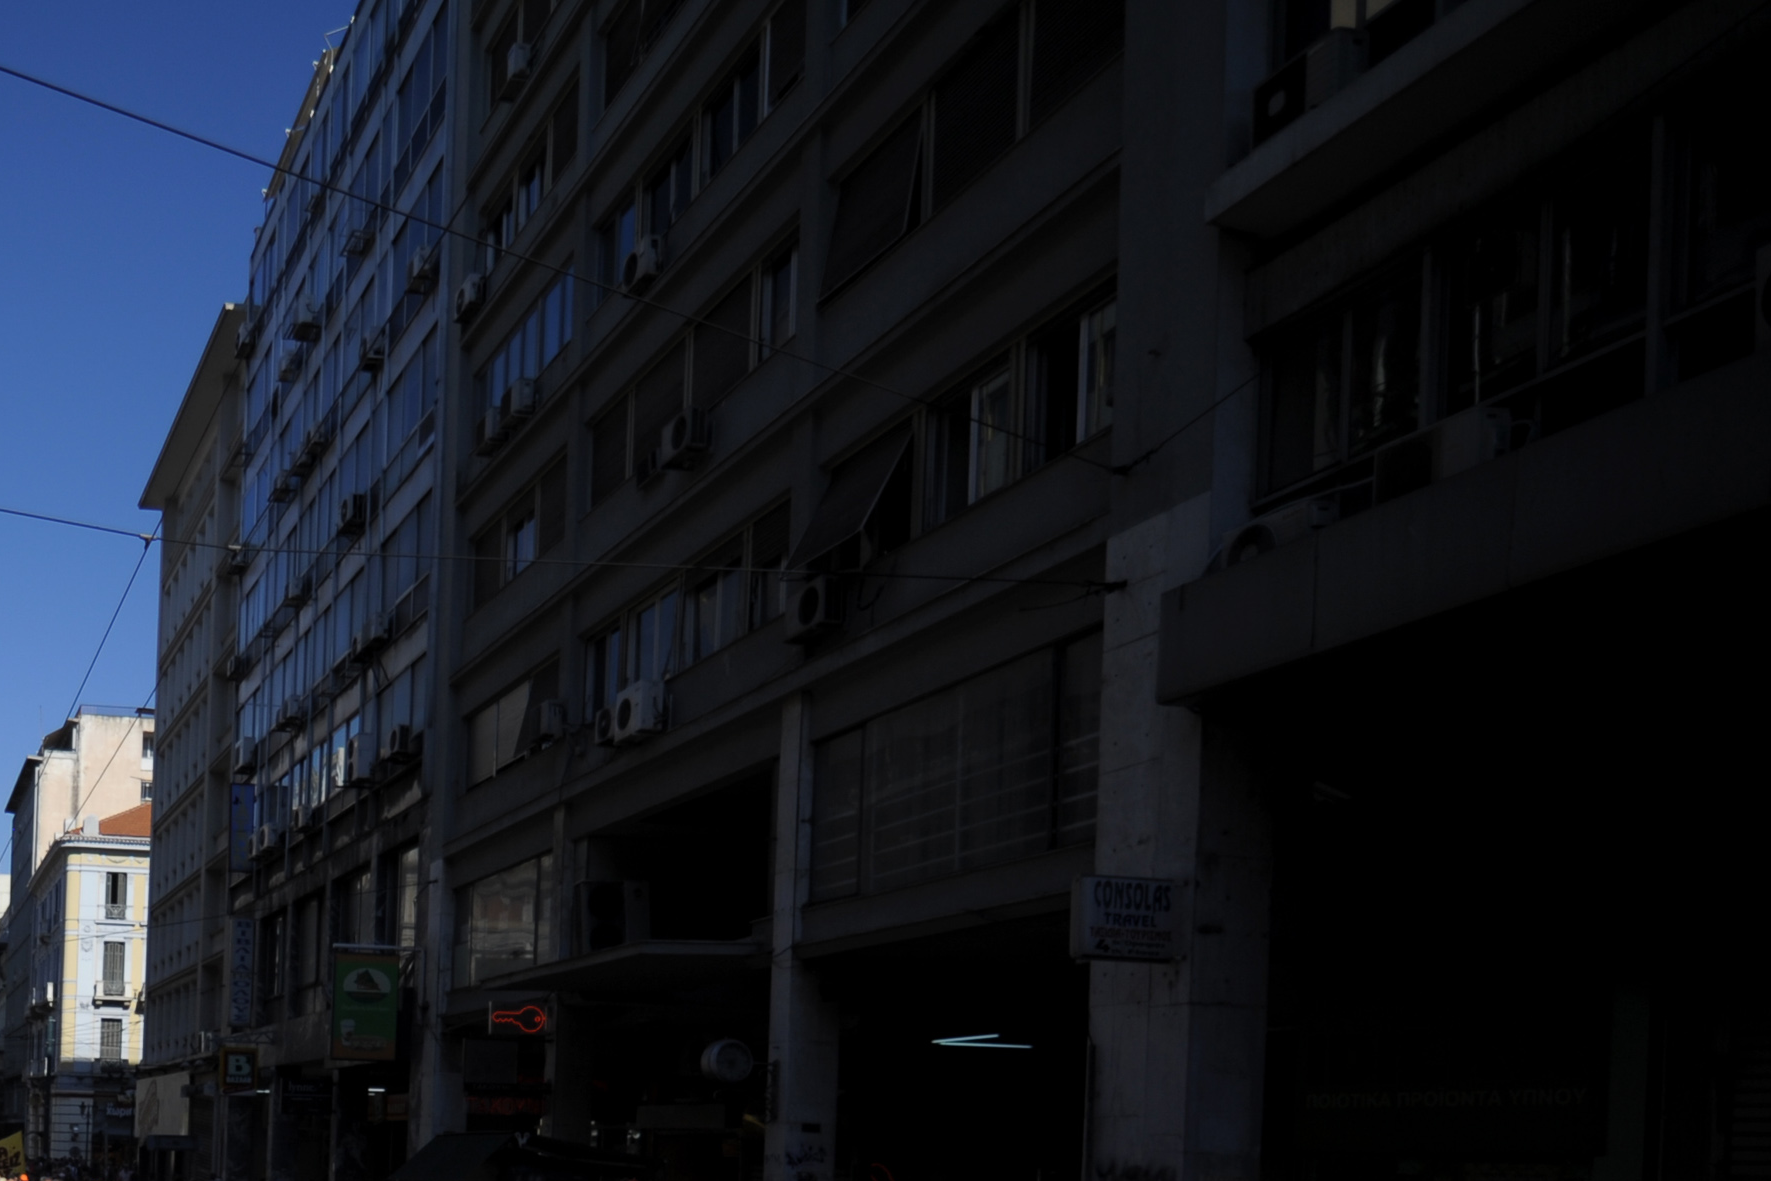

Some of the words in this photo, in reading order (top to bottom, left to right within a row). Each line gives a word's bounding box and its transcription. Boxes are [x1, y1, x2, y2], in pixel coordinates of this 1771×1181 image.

[1094, 880, 1172, 913] CONSOLAS
[1103, 911, 1157, 928] TRAVEL
[228, 1055, 252, 1076] B
[1508, 1087, 1588, 1106] ΥΠΝΟΥ
